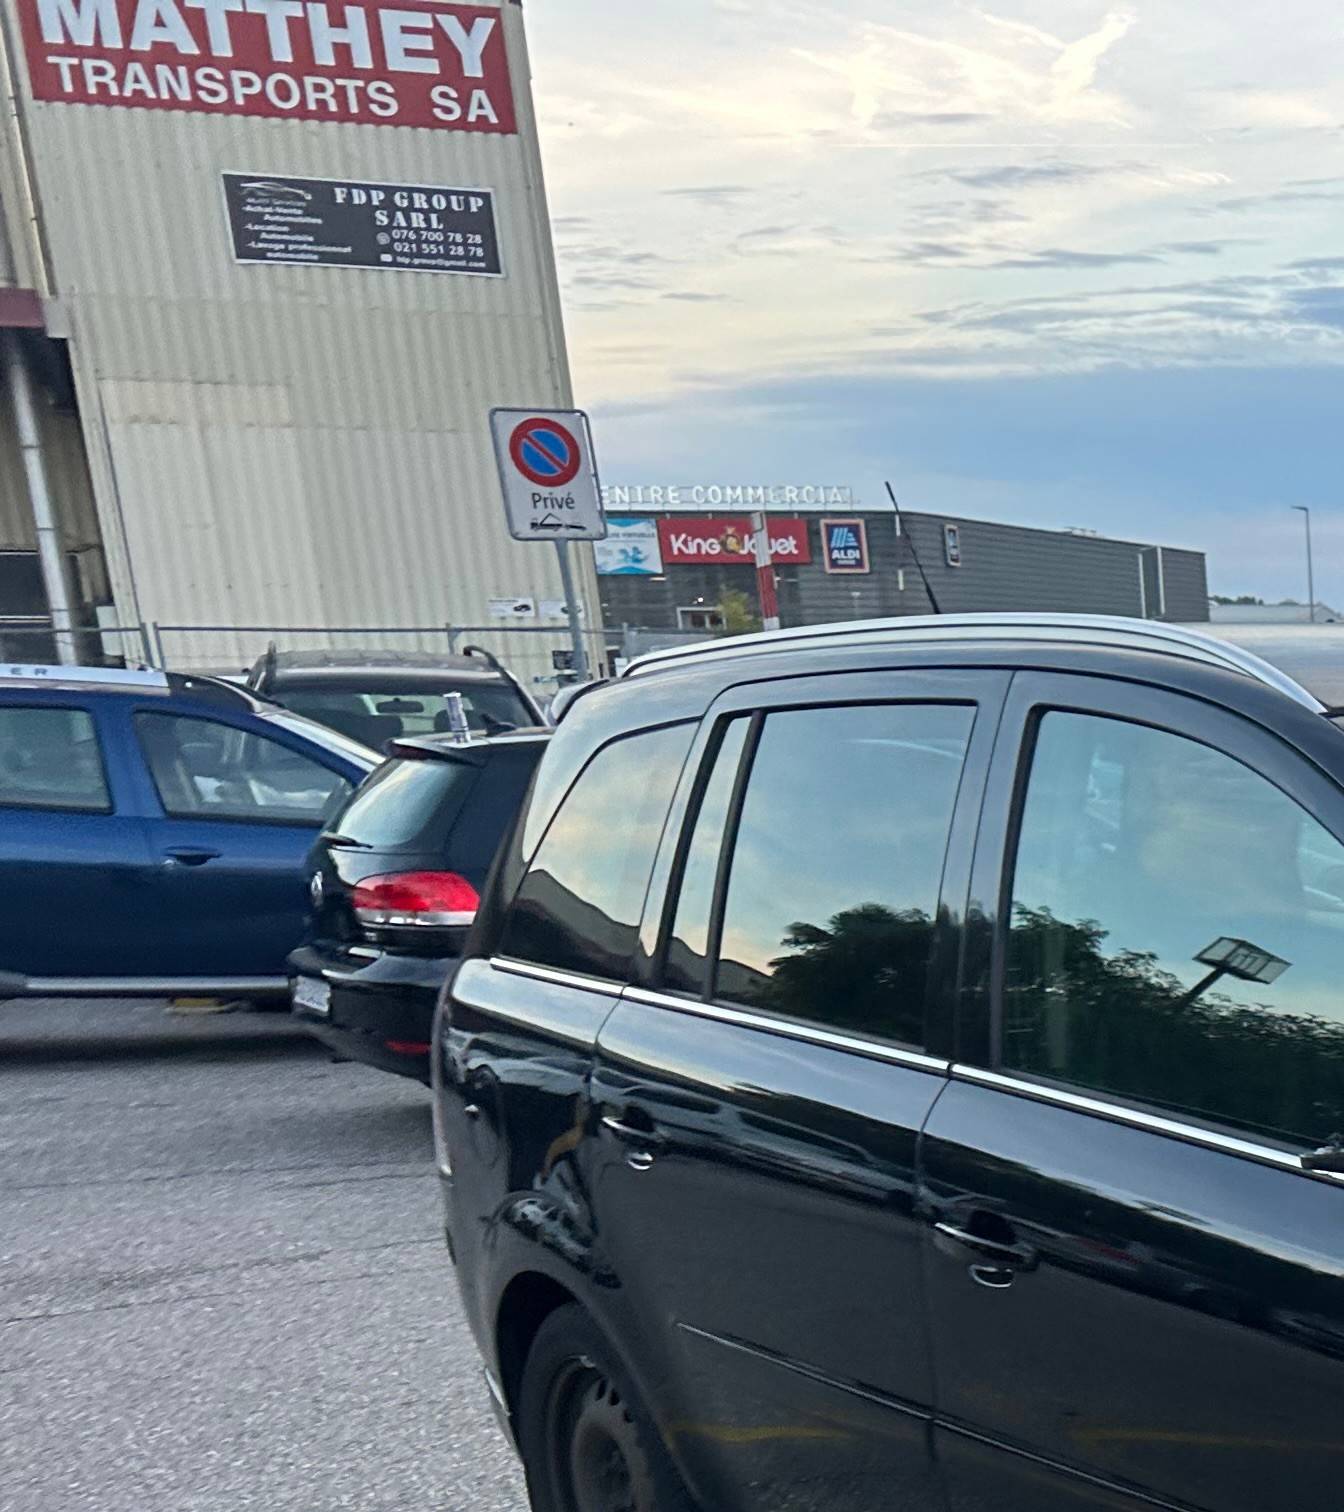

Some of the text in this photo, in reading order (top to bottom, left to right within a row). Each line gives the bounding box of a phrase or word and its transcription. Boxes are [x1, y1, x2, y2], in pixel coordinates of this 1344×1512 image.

[37, 0, 496, 78] MATTHEY
[47, 56, 499, 124] TRANSPORTS SA
[333, 187, 484, 213] FDP GROUP
[374, 209, 444, 230] SARL
[391, 229, 482, 244] 076 700 78 28
[393, 242, 484, 257] 021 551 28 78
[531, 492, 575, 510] Privé
[601, 485, 681, 503] ENTRE
[831, 549, 861, 559] ALDI
